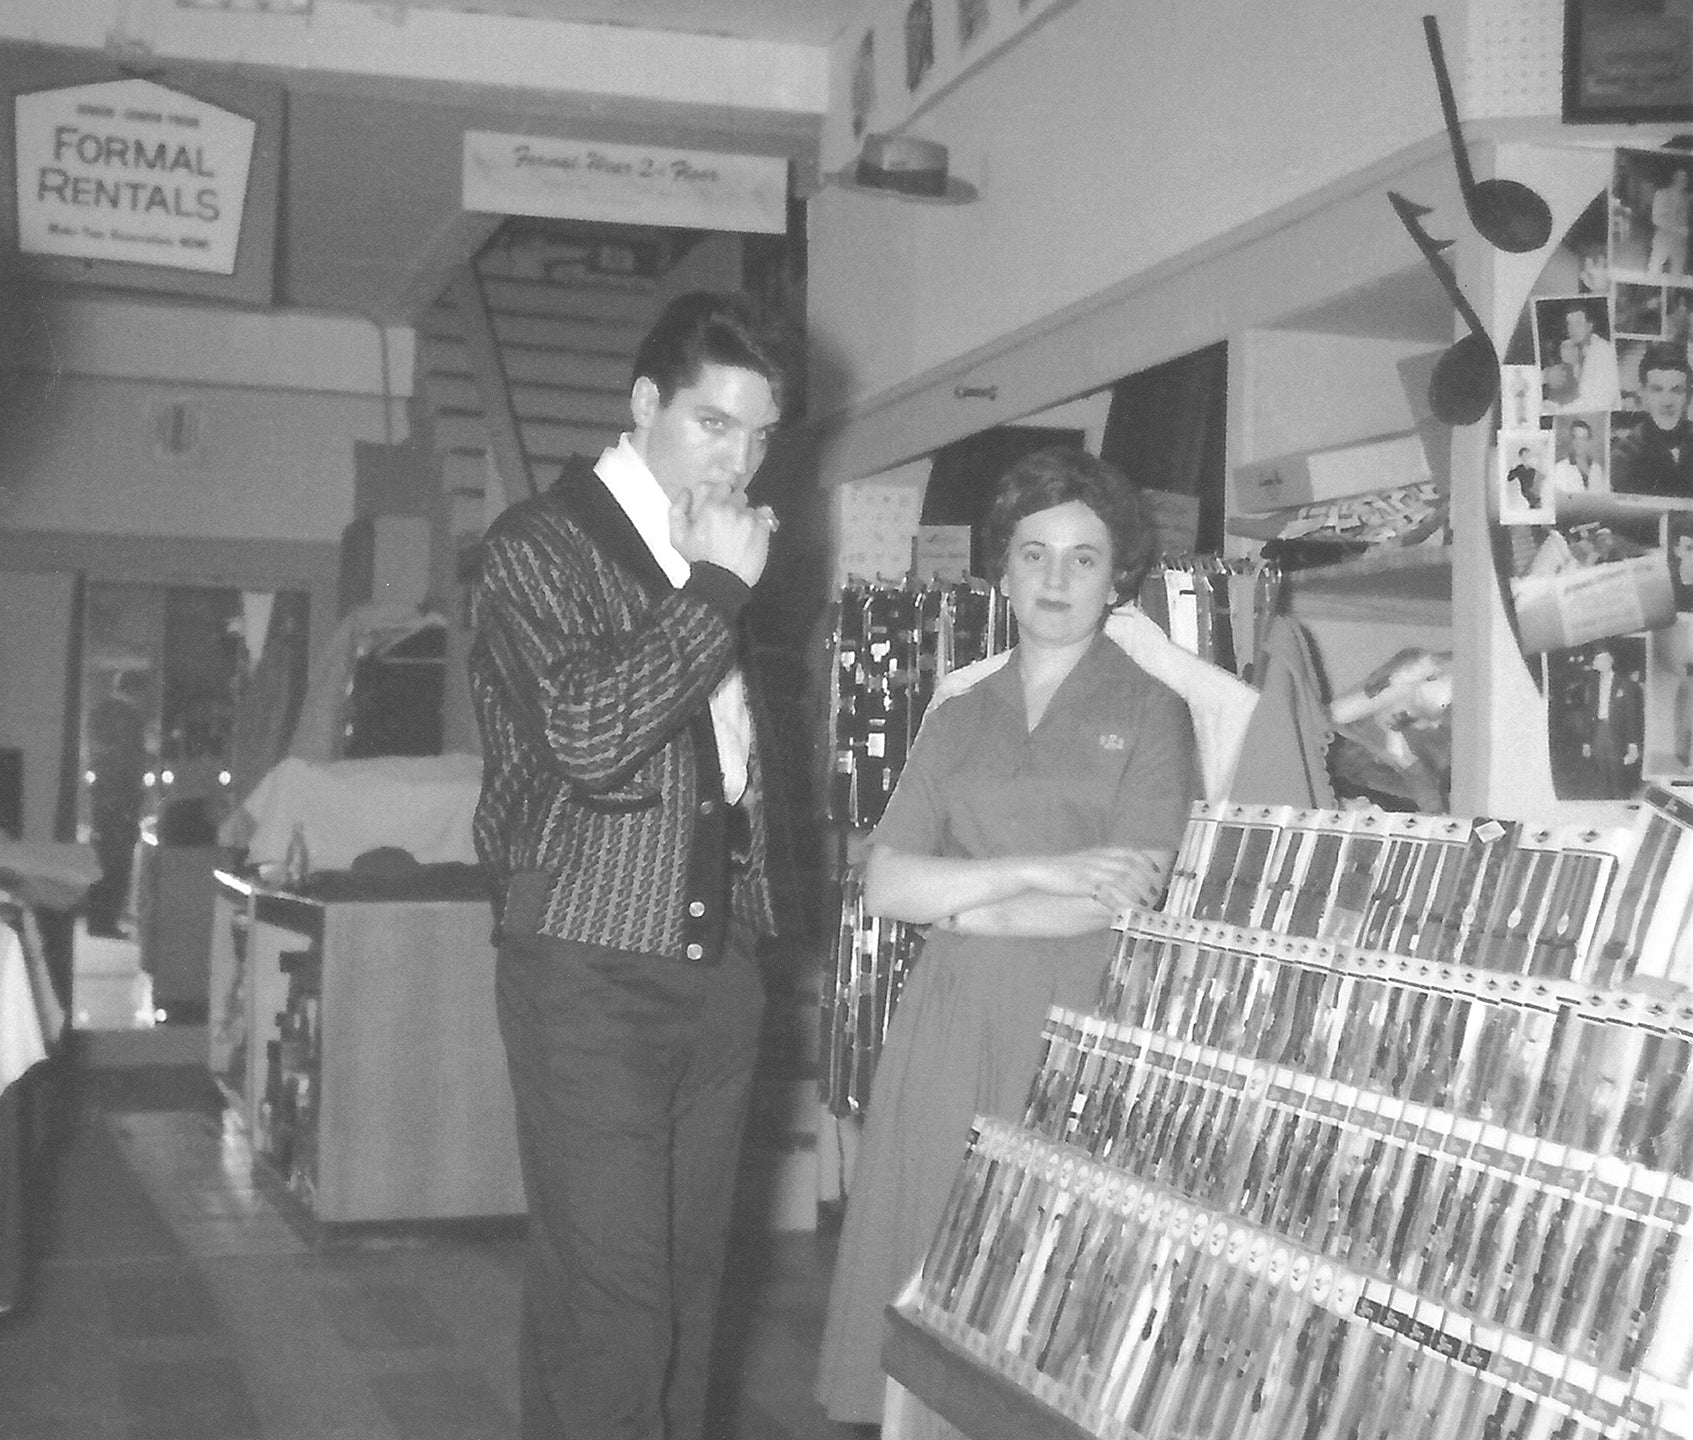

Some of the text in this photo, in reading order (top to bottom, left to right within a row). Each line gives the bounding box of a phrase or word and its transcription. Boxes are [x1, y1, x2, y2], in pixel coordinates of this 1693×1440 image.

[54, 126, 214, 178] FORMAL
[514, 145, 579, 169] Formal
[670, 160, 719, 182] Floor
[38, 167, 220, 222] RENTALS
